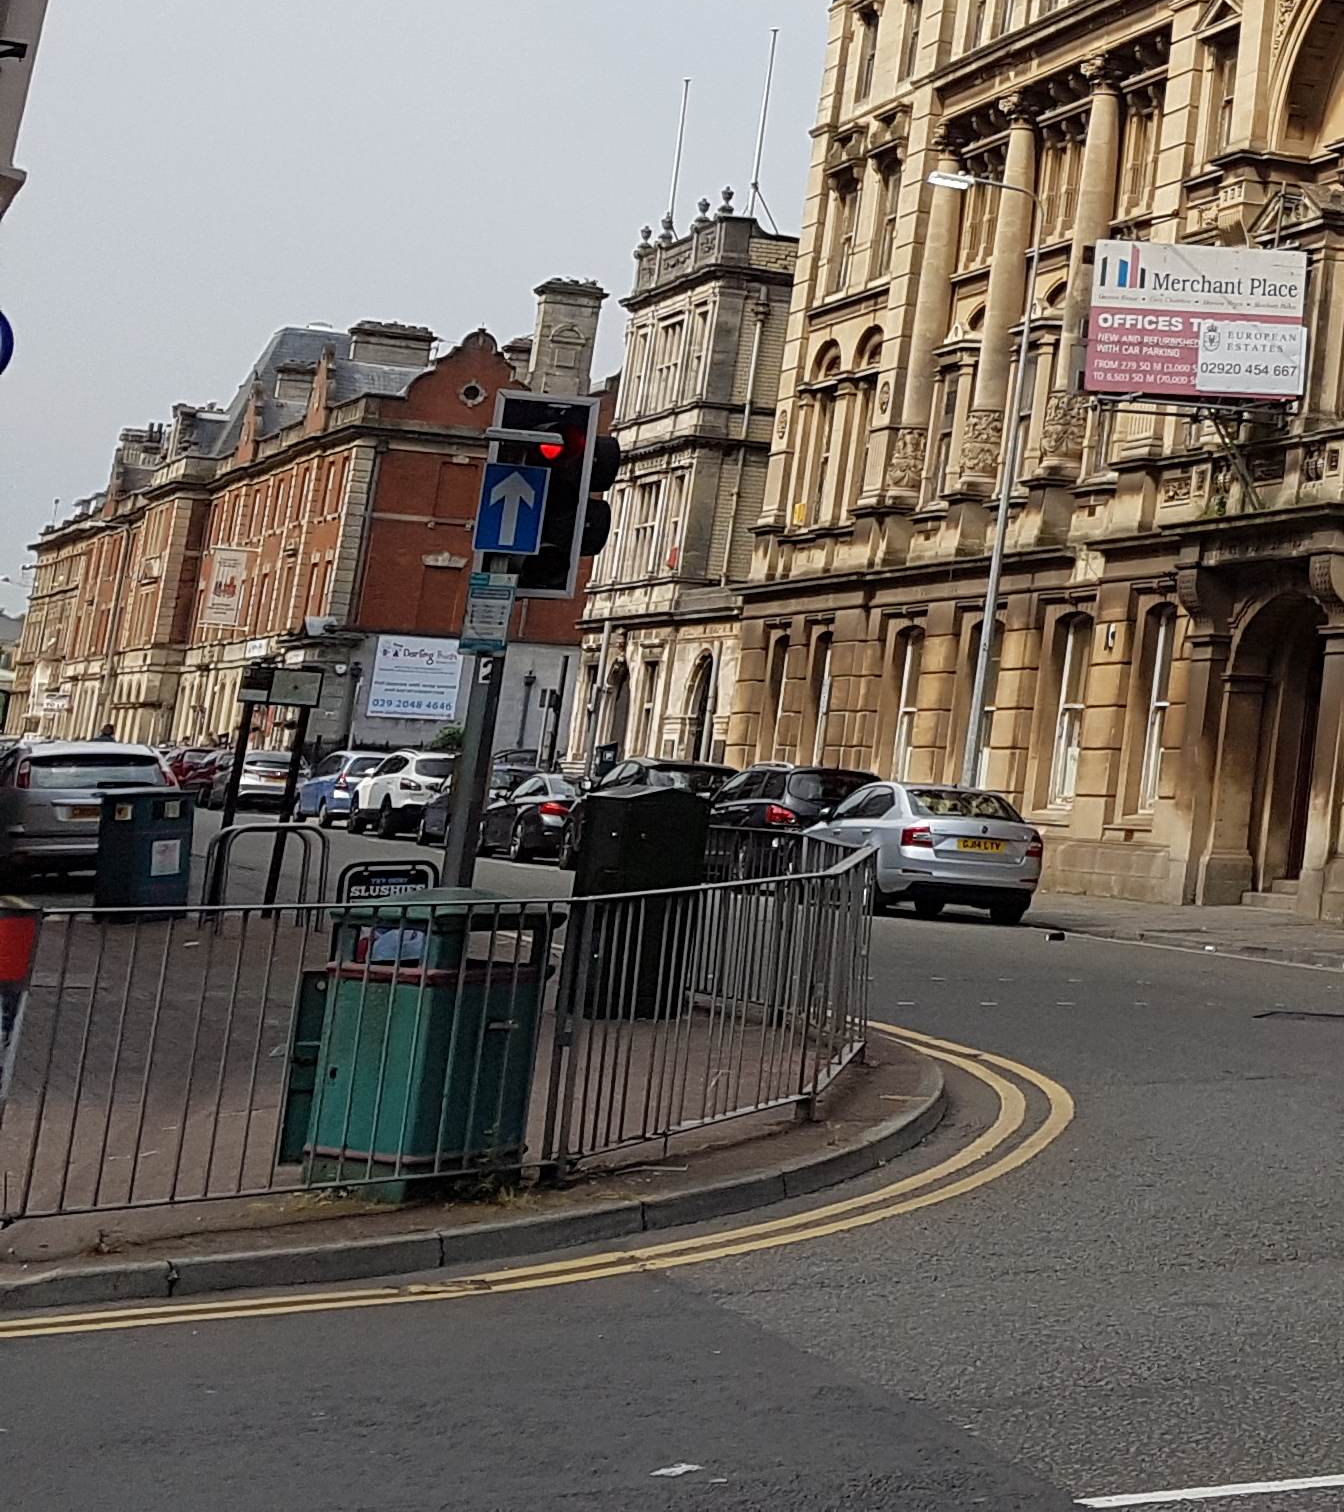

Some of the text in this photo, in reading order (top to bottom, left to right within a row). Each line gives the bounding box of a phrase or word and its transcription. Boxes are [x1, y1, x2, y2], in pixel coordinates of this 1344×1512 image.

[1152, 272, 1299, 298] Merchant Place
[1098, 313, 1183, 331] OFFICES
[1097, 332, 1119, 343] NEW
[1121, 334, 1141, 344] AND
[1227, 330, 1297, 342] EUROPEAN
[1096, 343, 1180, 358] WITH CAR PARKING
[1226, 342, 1284, 353] ESTATES
[1093, 358, 1119, 369] FROM
[1139, 361, 1151, 371] SQ
[1200, 361, 1298, 377] 02920 454 667
[1092, 371, 1105, 381] TO
[1131, 373, 1143, 383] SQ
[481, 659, 494, 681] 2
[372, 698, 452, 711] 029 2048 4646
